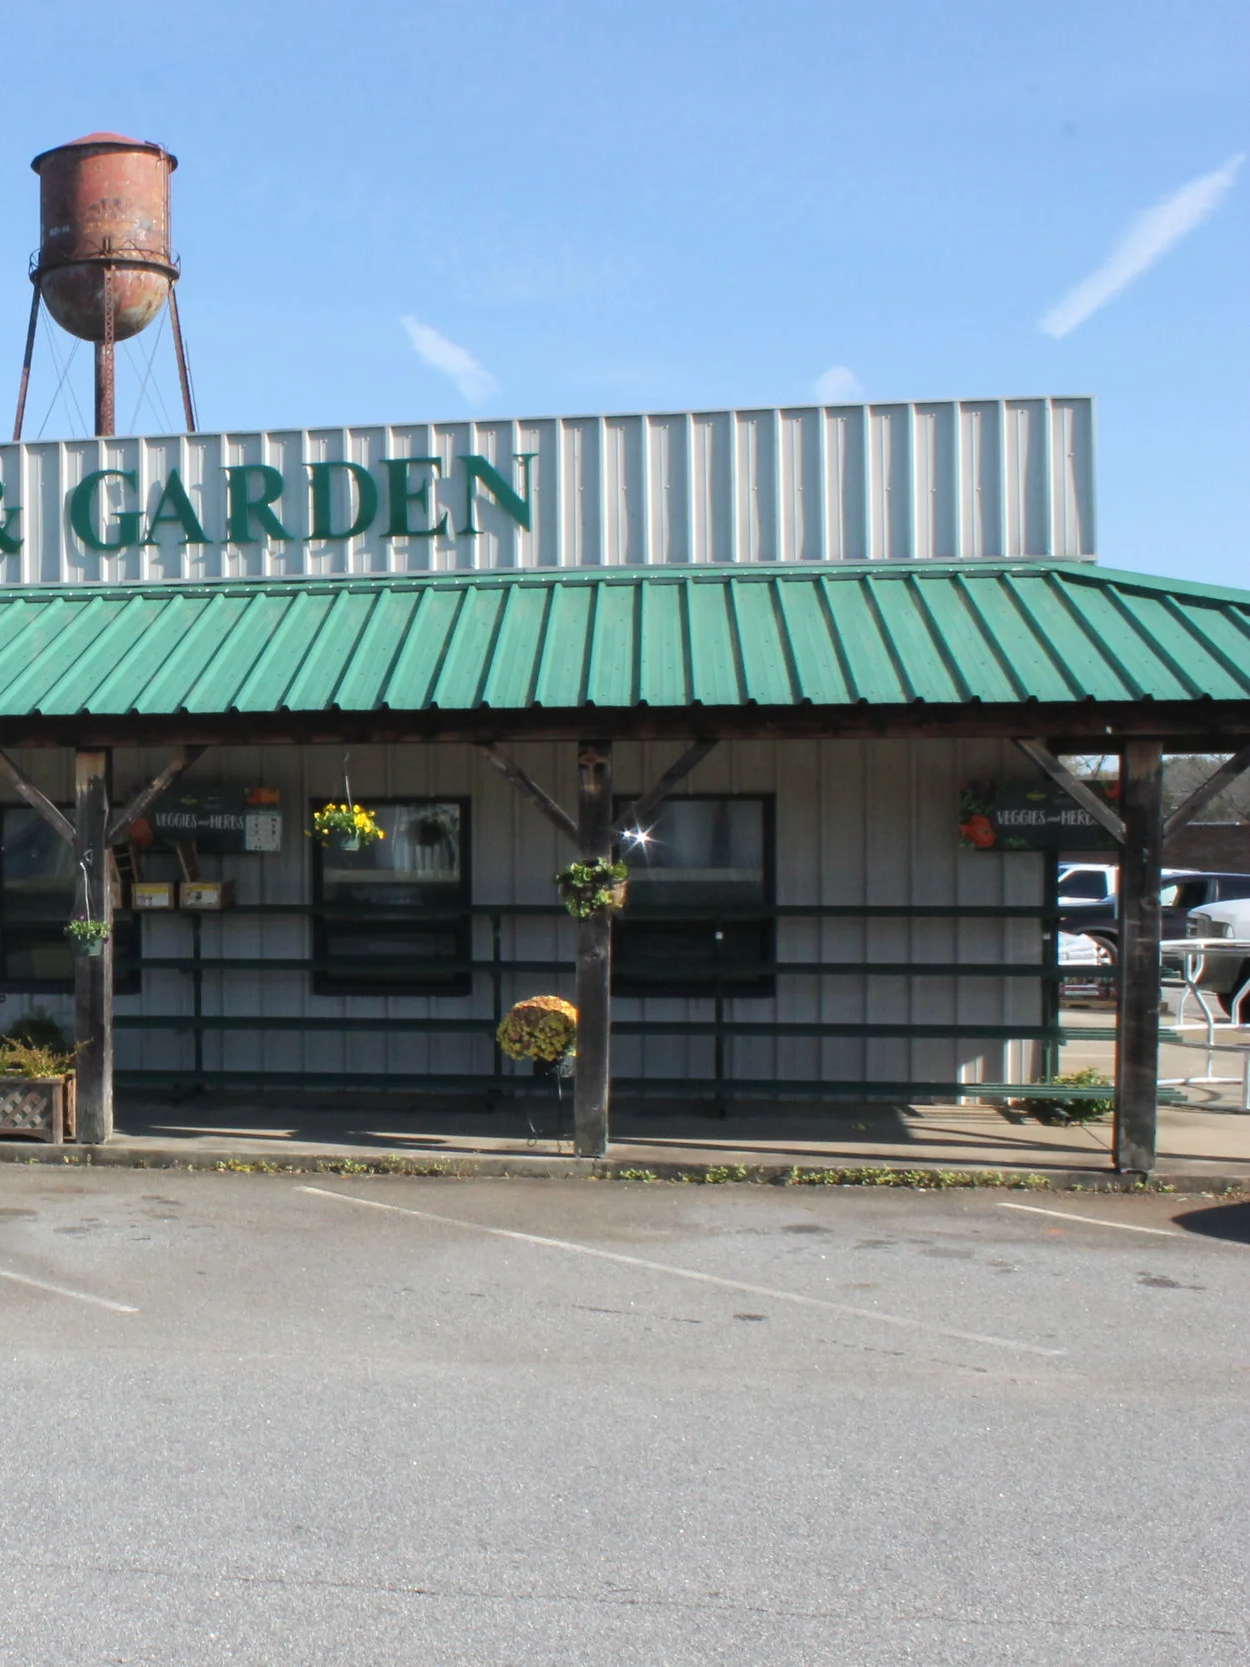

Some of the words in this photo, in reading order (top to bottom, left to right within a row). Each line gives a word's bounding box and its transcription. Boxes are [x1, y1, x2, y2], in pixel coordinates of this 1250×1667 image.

[70, 453, 539, 551] GARDEN
[155, 812, 197, 828] VEGGIES
[210, 814, 244, 829] HERBS
[997, 809, 1046, 825] VEGGIES
